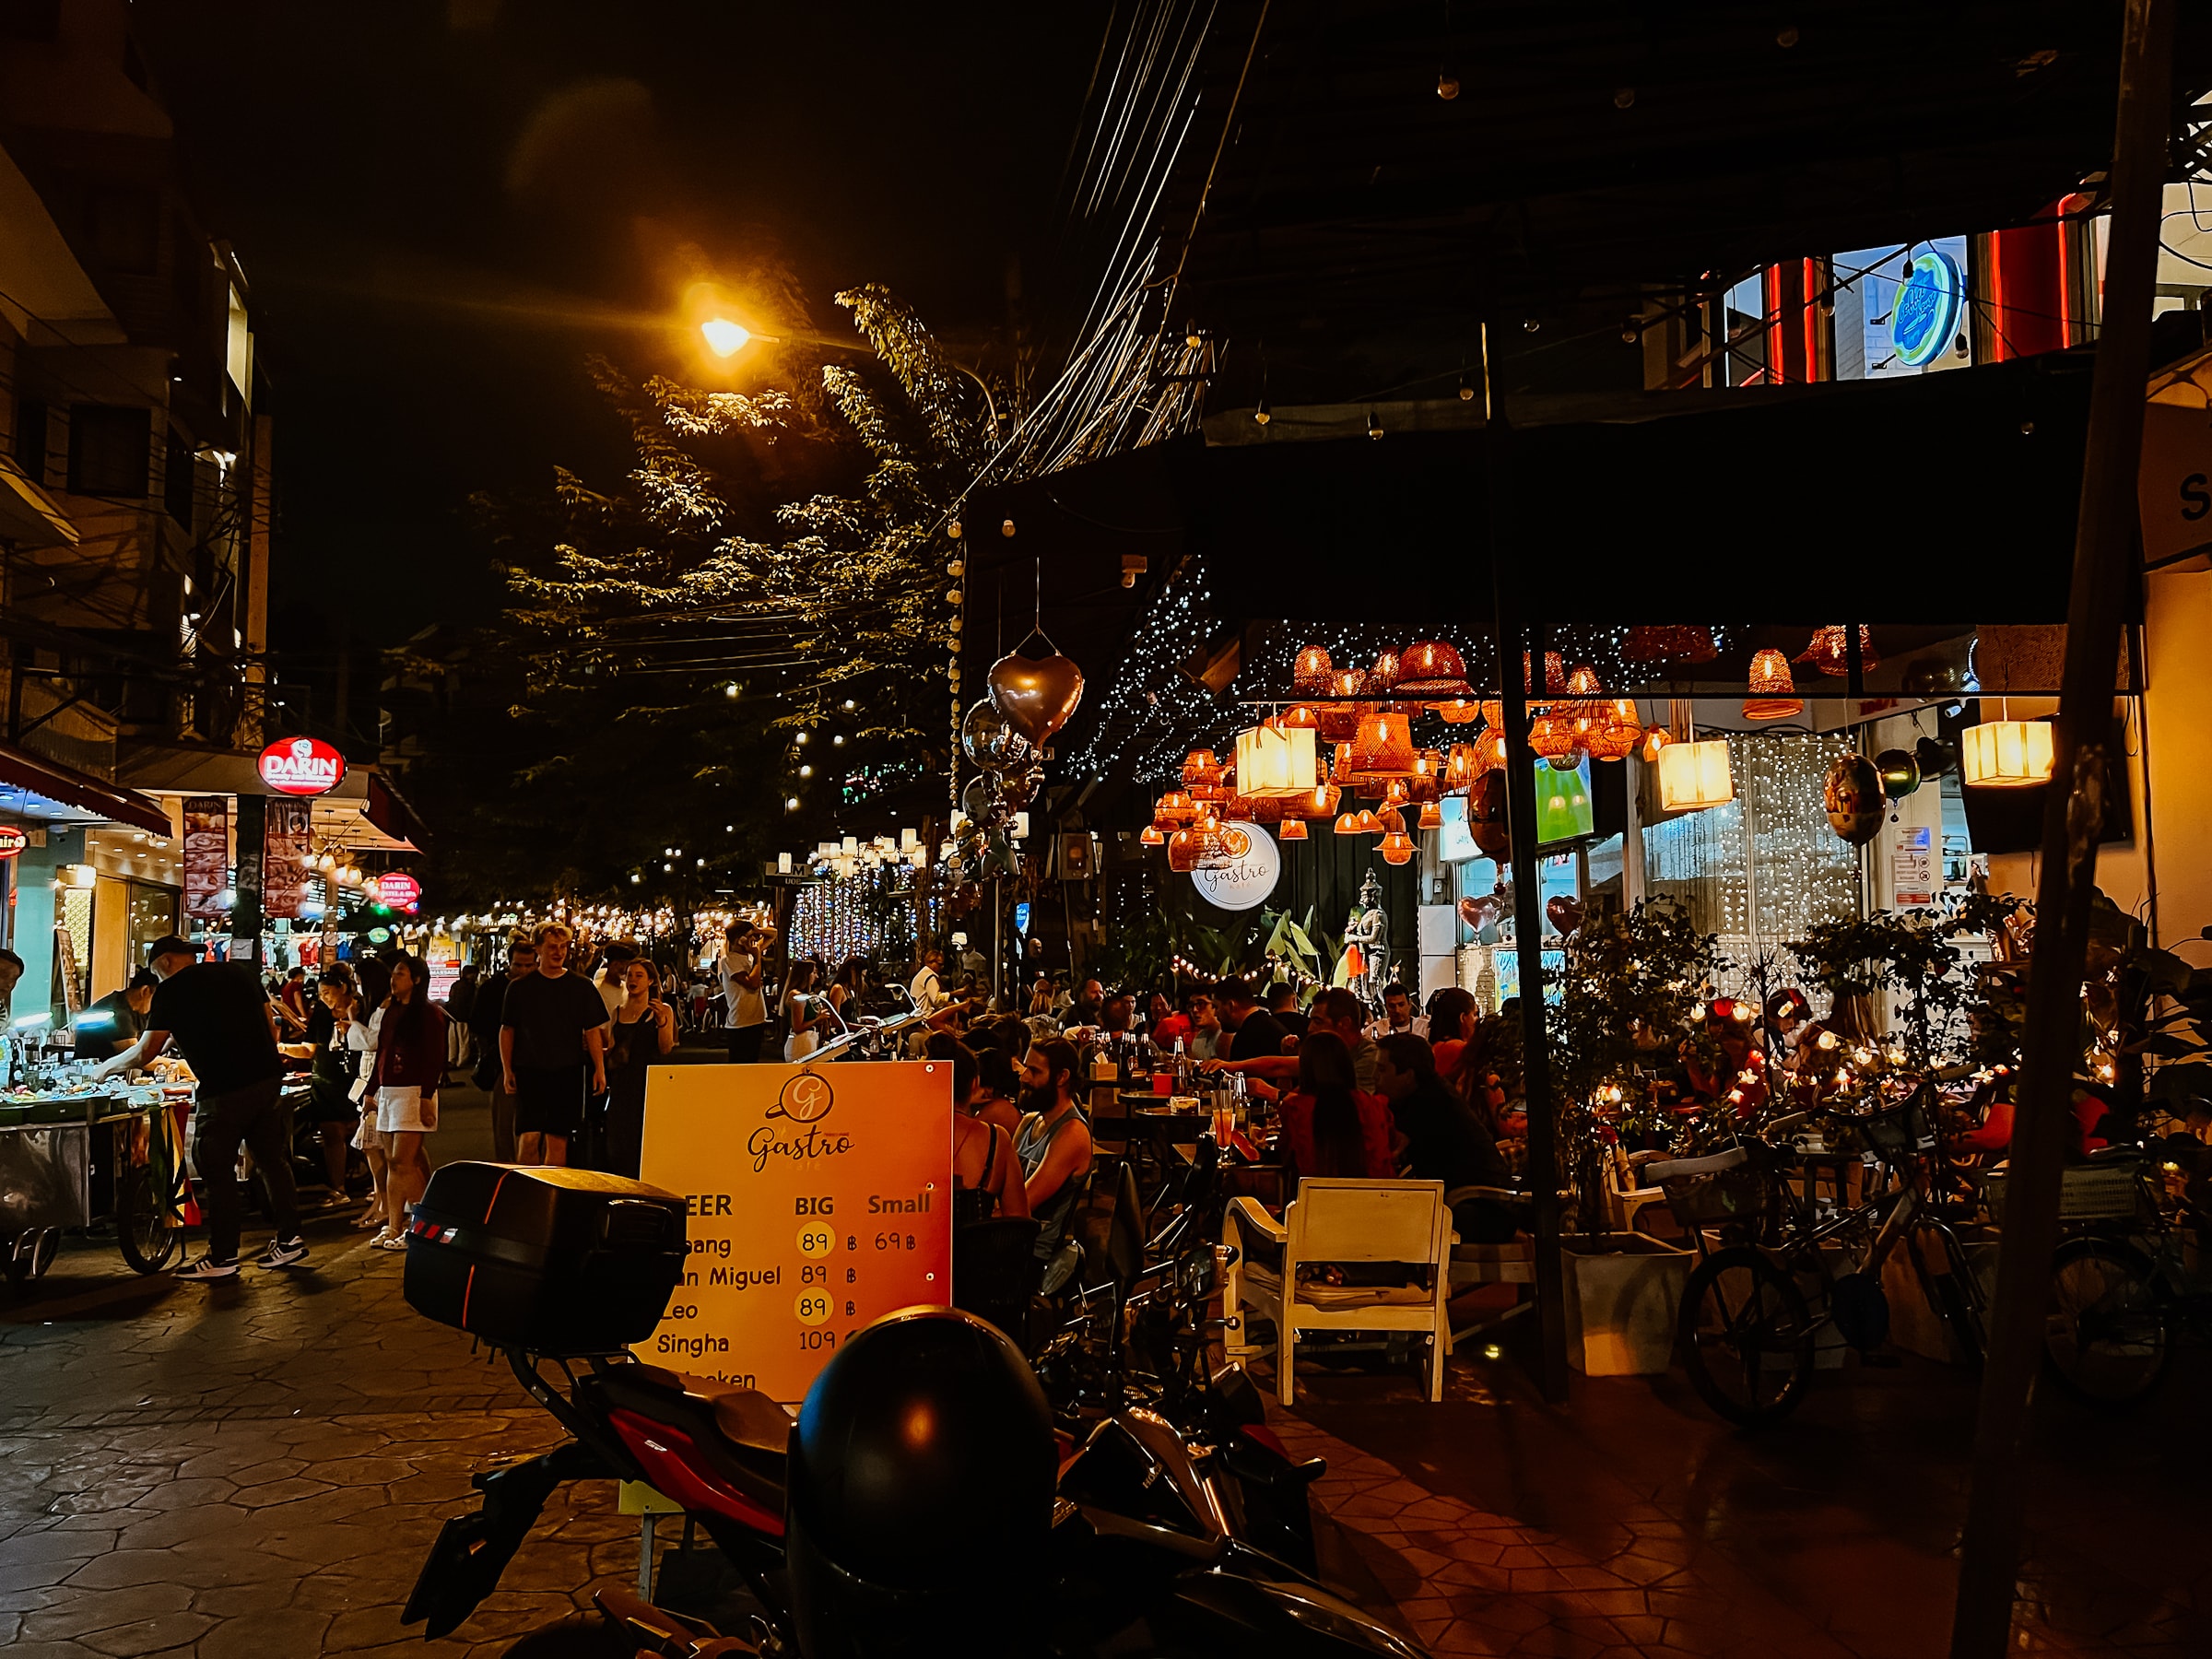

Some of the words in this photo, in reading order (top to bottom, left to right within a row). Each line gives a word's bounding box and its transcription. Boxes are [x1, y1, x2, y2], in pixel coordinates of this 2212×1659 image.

[265, 755, 337, 775] DARIN
[747, 1124, 855, 1173] Gastro
[685, 1194, 733, 1217] EER
[795, 1196, 834, 1216] BIG
[867, 1194, 930, 1214] Small
[687, 1239, 732, 1259] ang
[802, 1233, 828, 1251] 89
[875, 1232, 900, 1250] 69
[709, 1265, 781, 1291] Miguel
[801, 1265, 827, 1284] 89
[800, 1298, 826, 1317] 89
[657, 1333, 730, 1359] Singha
[799, 1331, 836, 1350] 109
